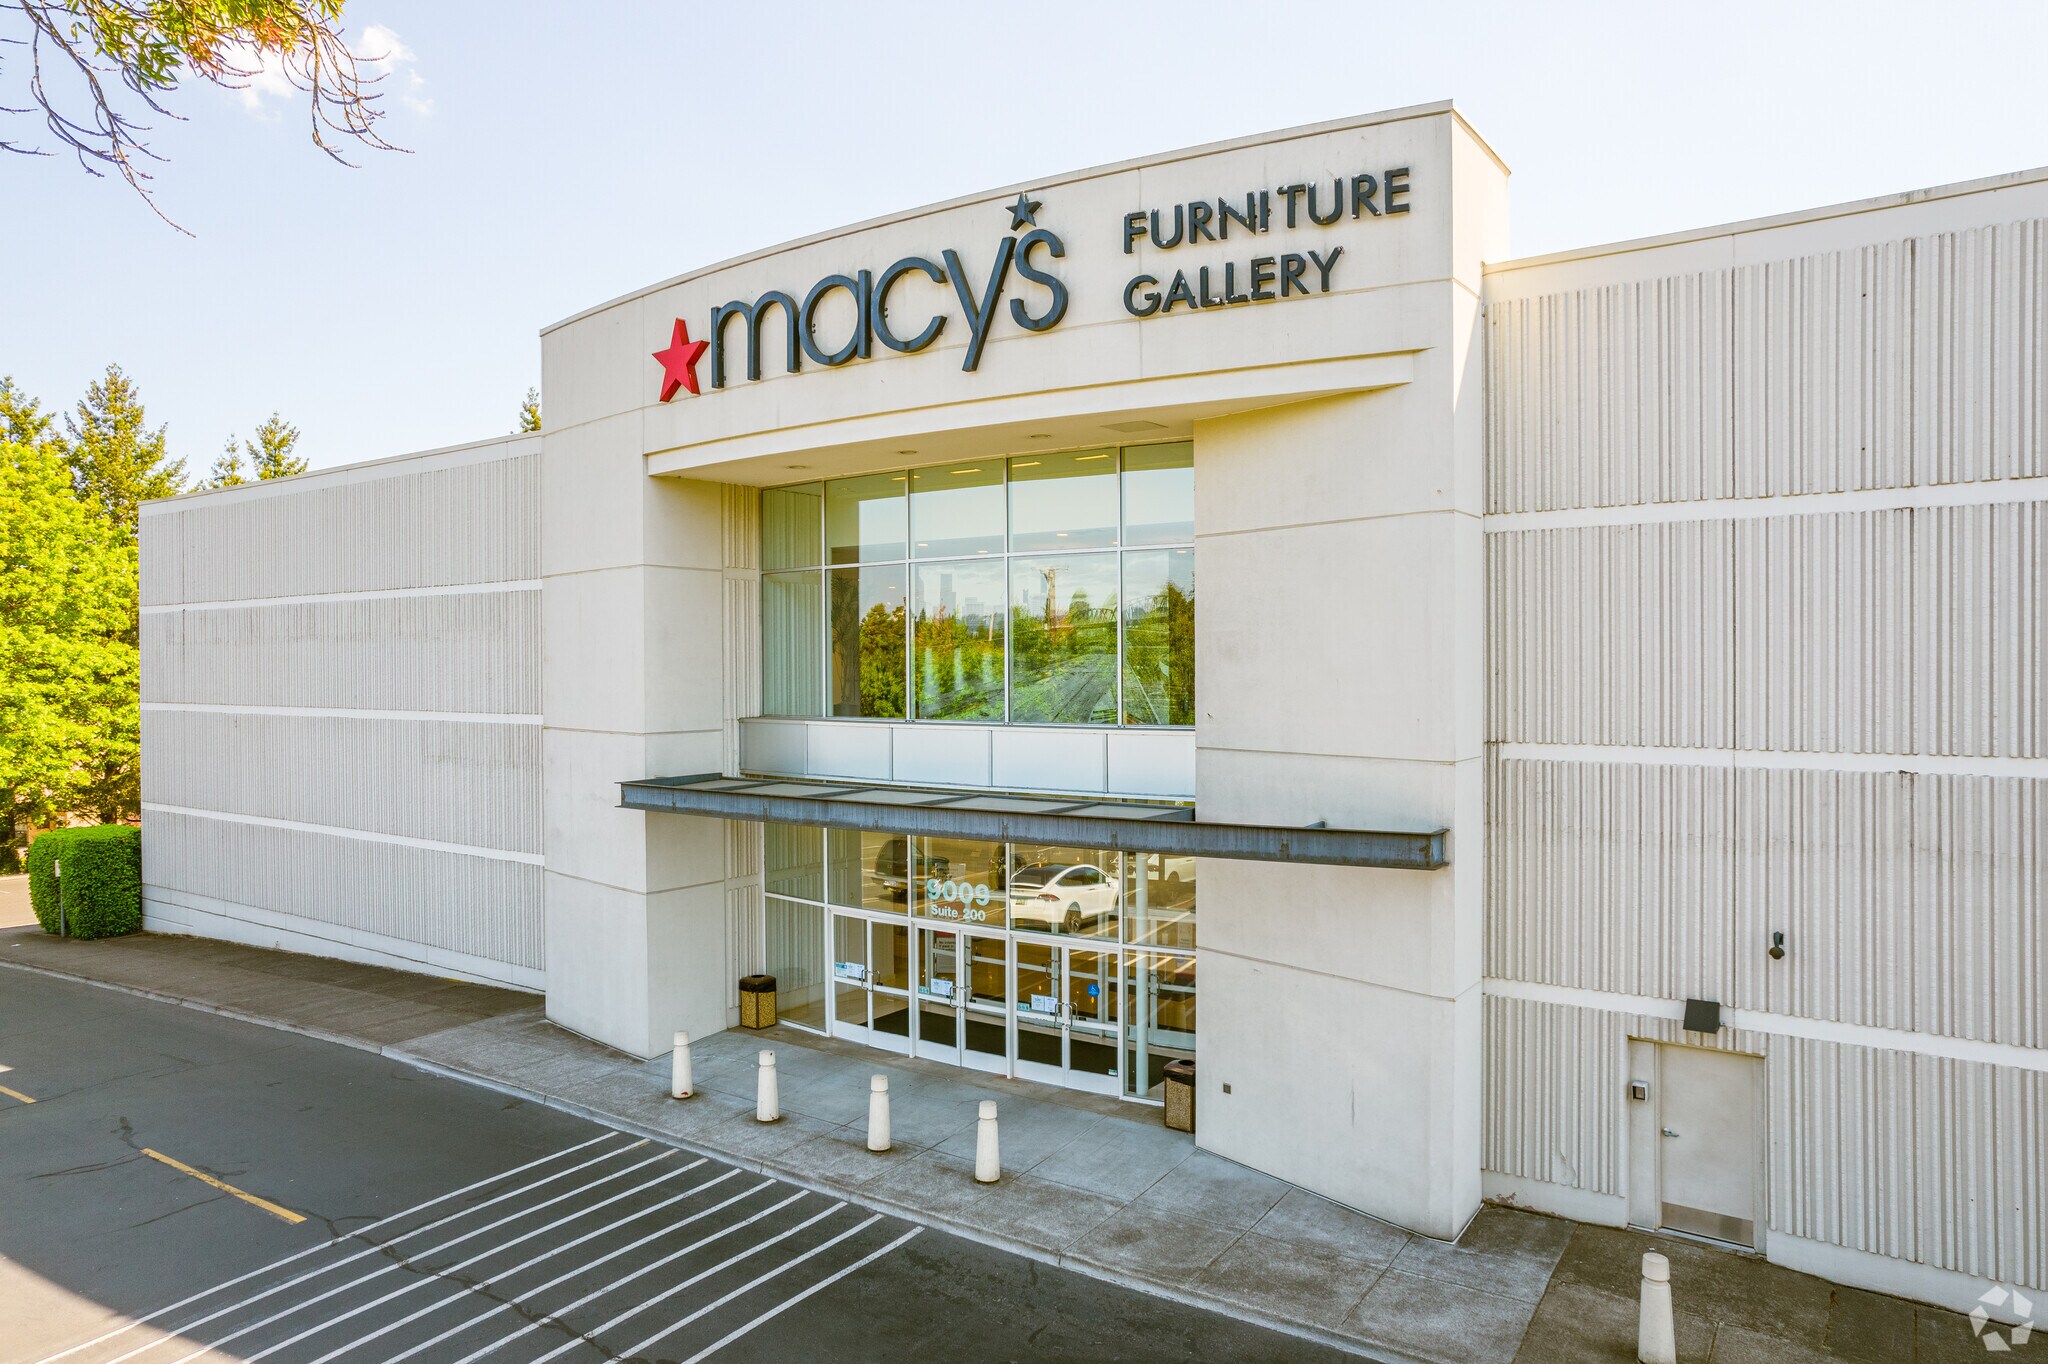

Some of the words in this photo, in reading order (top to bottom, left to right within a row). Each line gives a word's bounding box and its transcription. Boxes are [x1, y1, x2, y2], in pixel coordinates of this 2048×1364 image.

[1123, 167, 1410, 254] FURNITURE
[1123, 246, 1345, 317] GALLERY
[927, 878, 990, 906] 9009
[930, 904, 959, 918] Suite
[963, 908, 986, 922] 200
